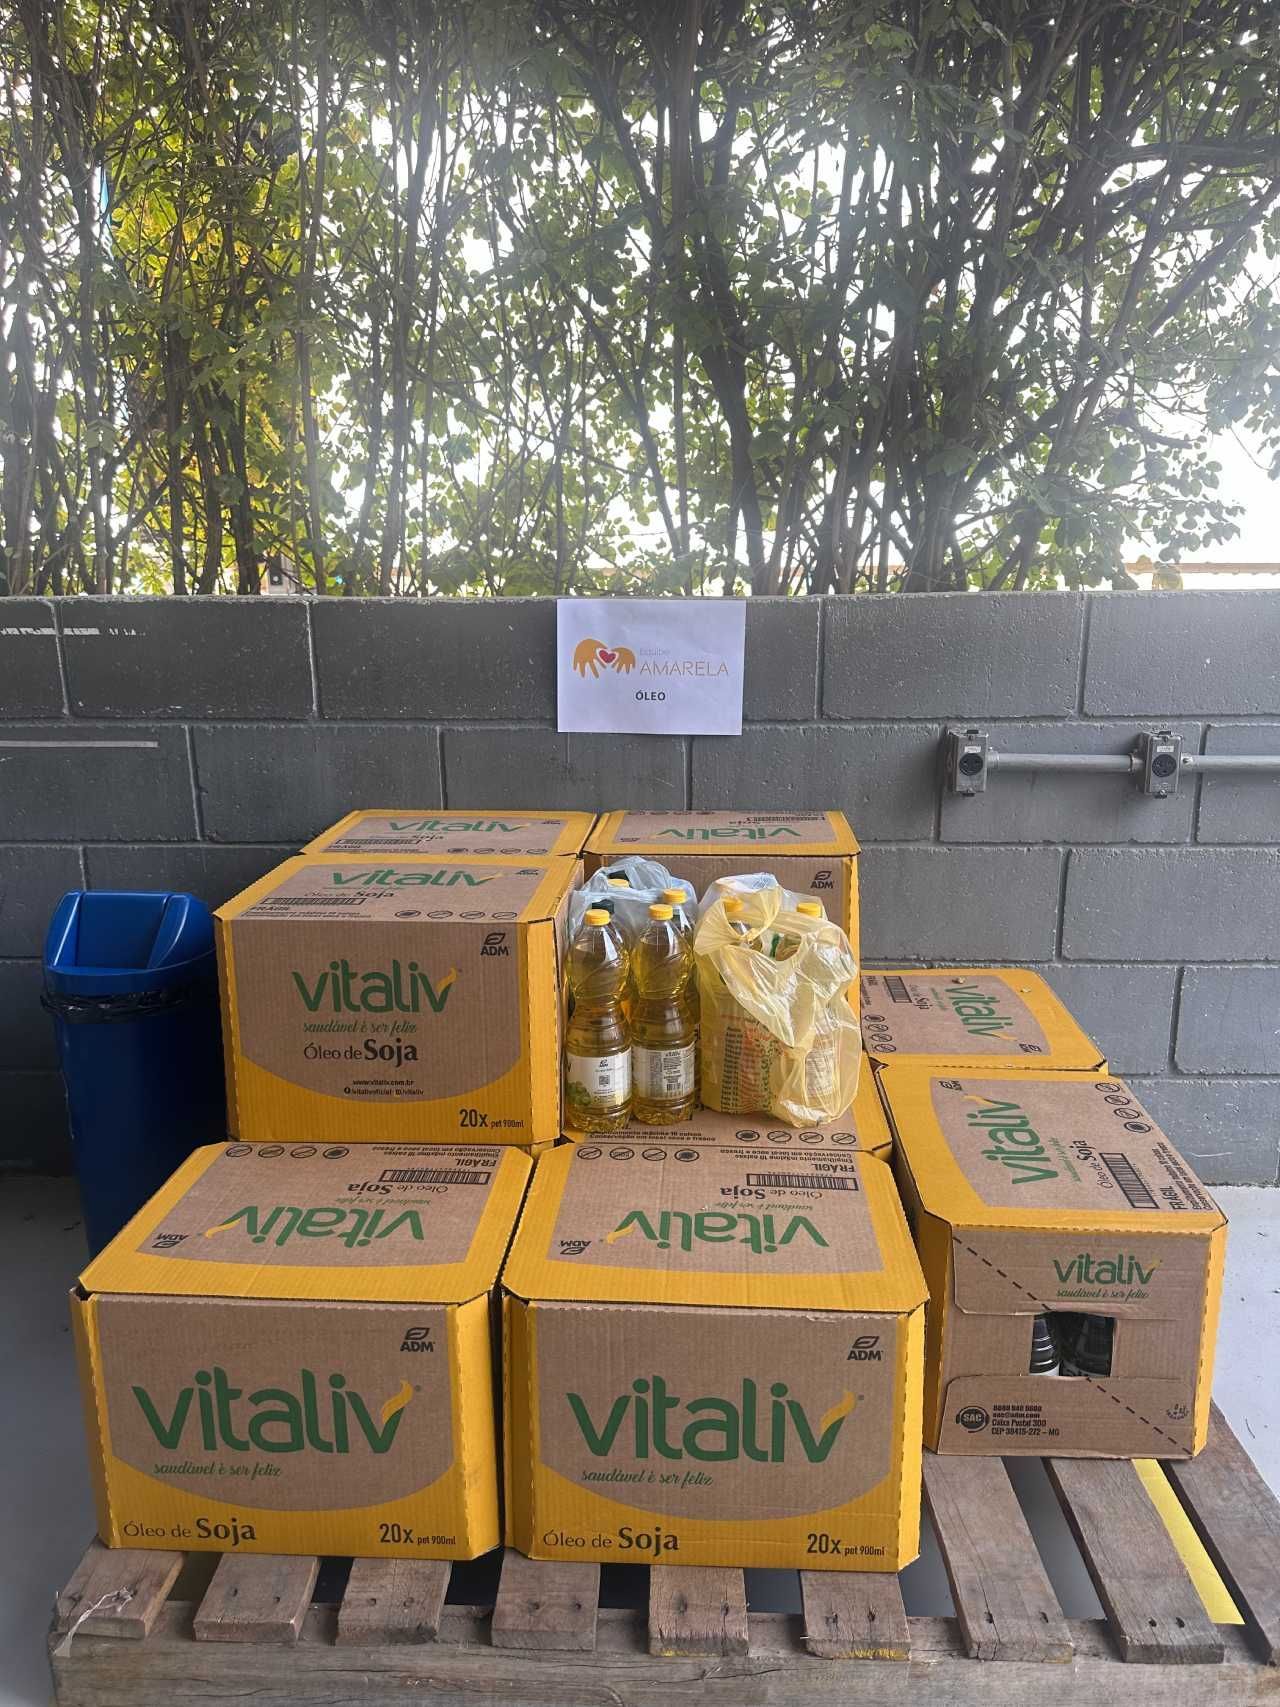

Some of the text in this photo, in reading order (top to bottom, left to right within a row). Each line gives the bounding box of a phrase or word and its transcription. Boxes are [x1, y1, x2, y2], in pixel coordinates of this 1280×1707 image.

[639, 661, 729, 677] AMARELA
[635, 689, 666, 701] ÓLEO
[355, 890, 394, 899] Soja
[810, 880, 834, 889] ADM
[480, 946, 509, 956] ADM
[291, 959, 458, 1013] vitaliv
[303, 1038, 418, 1067] Óleo de Soja
[459, 1107, 488, 1128] 20x
[455, 1158, 497, 1167] FRÁGIL
[811, 1163, 855, 1173] FRÁGIL
[1068, 1139, 1114, 1189] Óleo de Soja
[347, 1181, 448, 1196] Óleo de Soja
[720, 1185, 823, 1200] Óleo de Soja
[1160, 1186, 1188, 1210] FRÁGIL
[204, 1205, 425, 1248] vitaliv
[606, 1210, 830, 1254] vitaliv
[157, 1233, 190, 1241] ADM
[1052, 1252, 1161, 1285] vitaliv
[400, 1341, 434, 1353] ADM
[847, 1350, 882, 1361] ADM
[132, 1366, 414, 1454] vitaliv
[566, 1375, 856, 1464] vitaliv
[963, 1413, 982, 1423] SAC
[991, 1419, 1010, 1427] Caixa
[1011, 1419, 1031, 1427] Postal
[1048, 1428, 1060, 1436] MG
[153, 1461, 216, 1476] saudável
[229, 1465, 250, 1476] ser
[250, 1461, 281, 1481] feliz
[581, 1468, 646, 1484] saudável
[659, 1473, 681, 1485] ser
[681, 1470, 713, 1489] feliz
[124, 1517, 256, 1546] Óleo de Soja
[379, 1522, 456, 1547] 20x pet 900ml
[543, 1527, 679, 1556] Óleo de Soja
[807, 1532, 885, 1557] 20x pet 900ml
